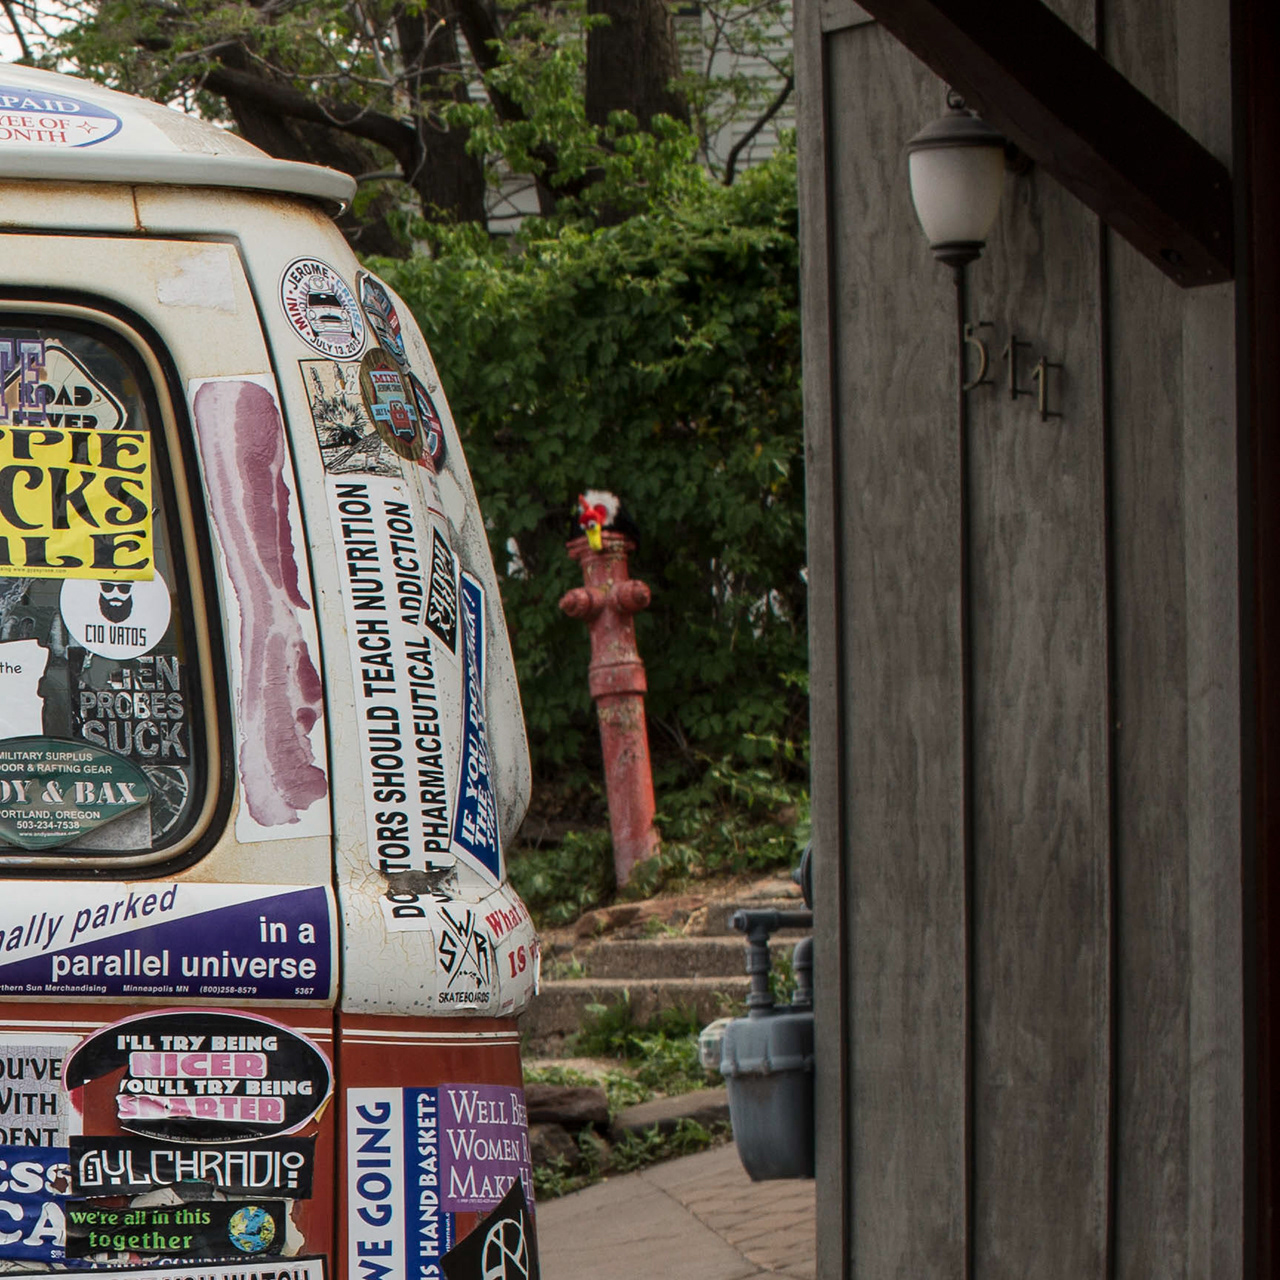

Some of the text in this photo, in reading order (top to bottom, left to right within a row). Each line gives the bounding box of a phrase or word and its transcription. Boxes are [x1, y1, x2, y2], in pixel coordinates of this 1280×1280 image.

[40, 117, 70, 130] OF
[45, 753, 93, 762] SURPLUS
[27, 764, 35, 773] &
[37, 764, 81, 774] RAFTING
[85, 765, 113, 775] GEAR
[41, 780, 65, 805] &
[74, 781, 137, 805] BAX
[57, 811, 101, 820] OREGON
[16, 821, 80, 830] 503-234-7538
[69, 884, 178, 943] parked
[260, 917, 316, 944] in a
[51, 948, 317, 983] parallel universe
[355, 1102, 393, 1228] GOING
